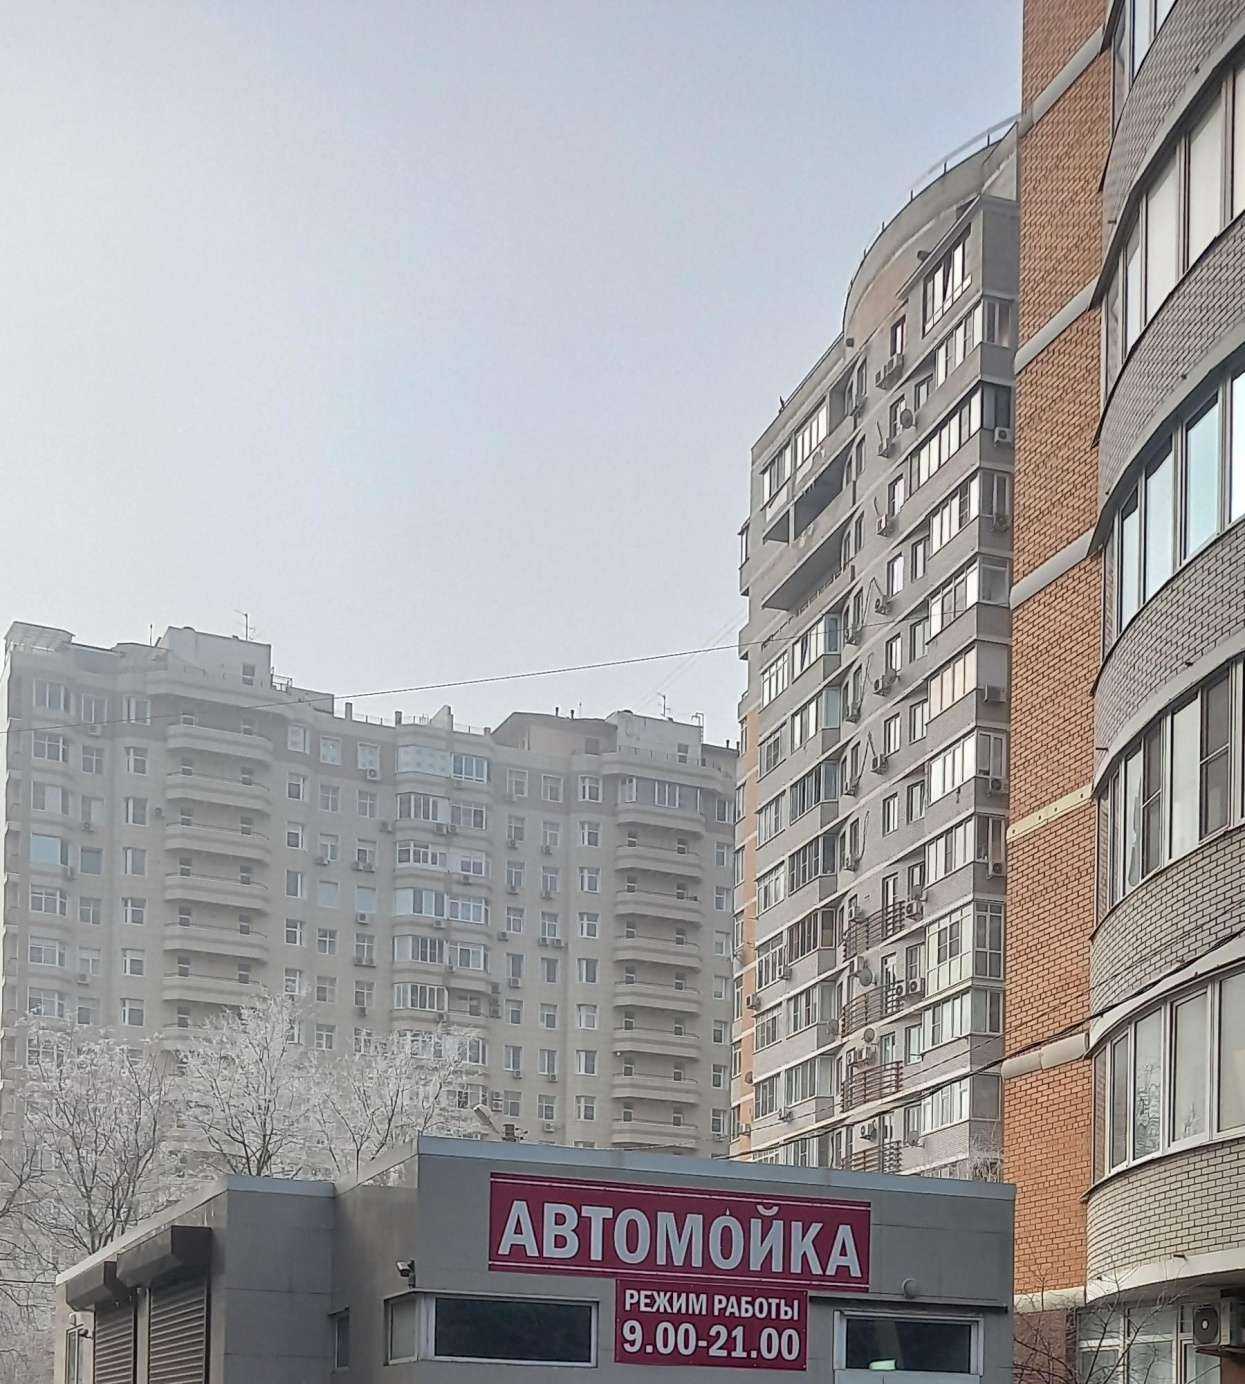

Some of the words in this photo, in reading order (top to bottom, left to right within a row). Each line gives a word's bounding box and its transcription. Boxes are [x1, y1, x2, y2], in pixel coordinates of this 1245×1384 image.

[497, 1200, 863, 1278] АВТОМОЙКА
[624, 1290, 707, 1315] РЕЖИМ
[713, 1295, 799, 1321] РАБОТЫ
[622, 1320, 801, 1361] 9.00-21.00
